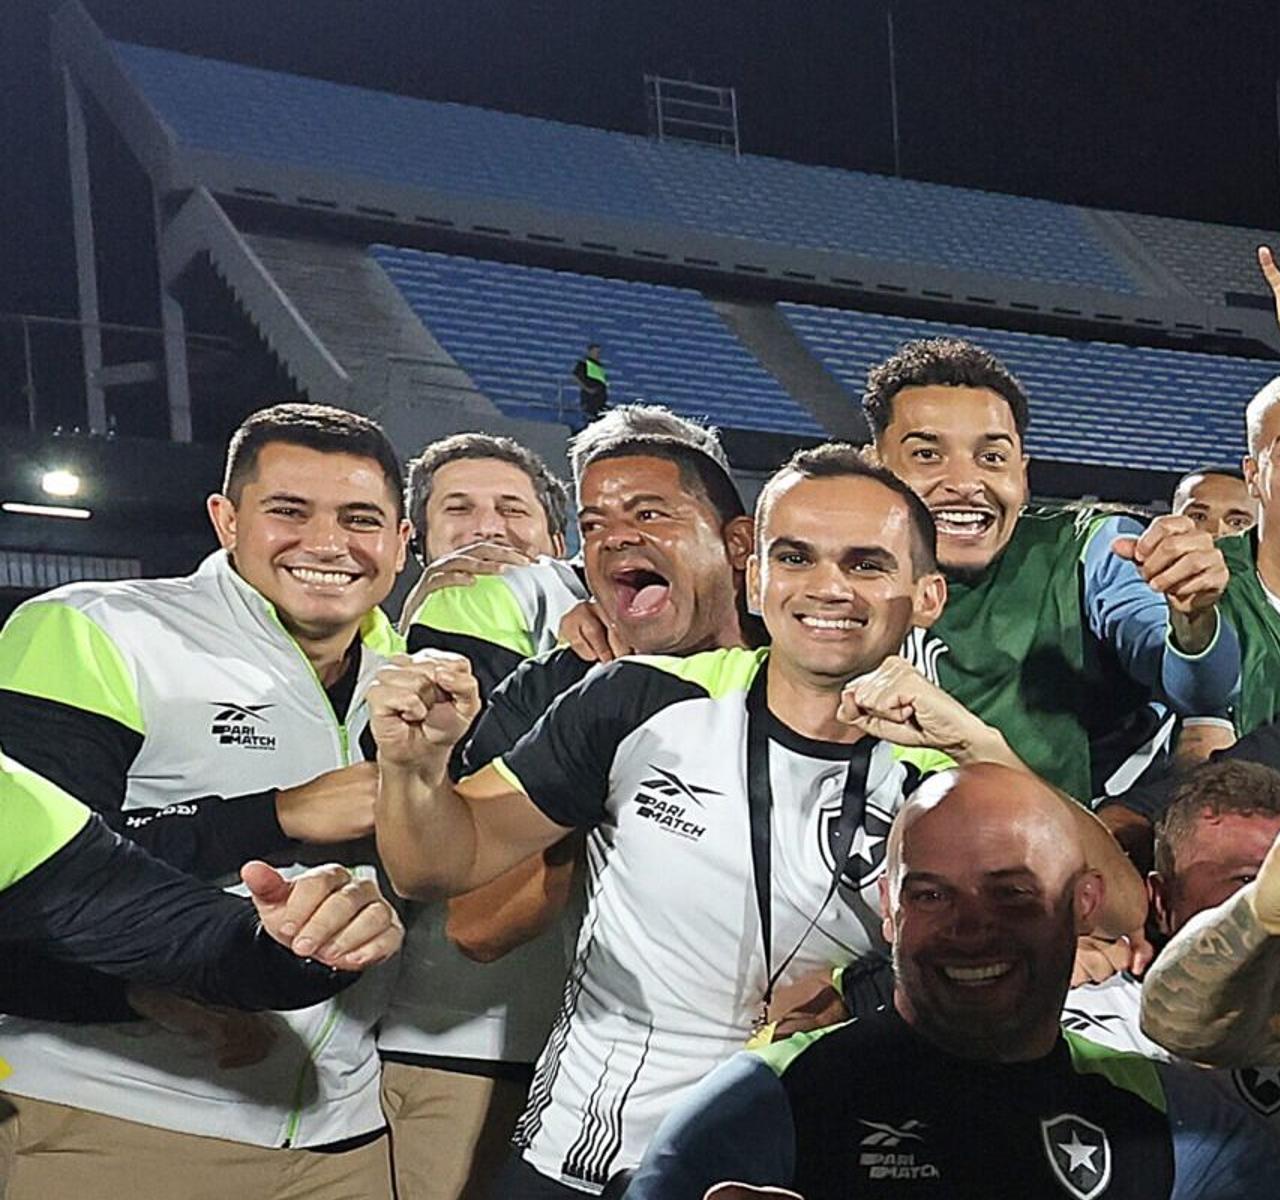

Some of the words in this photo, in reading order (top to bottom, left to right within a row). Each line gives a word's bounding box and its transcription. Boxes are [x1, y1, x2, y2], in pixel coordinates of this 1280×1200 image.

[219, 735, 276, 747] MATCH
[633, 792, 687, 818] PARI
[636, 806, 706, 837] MATCH
